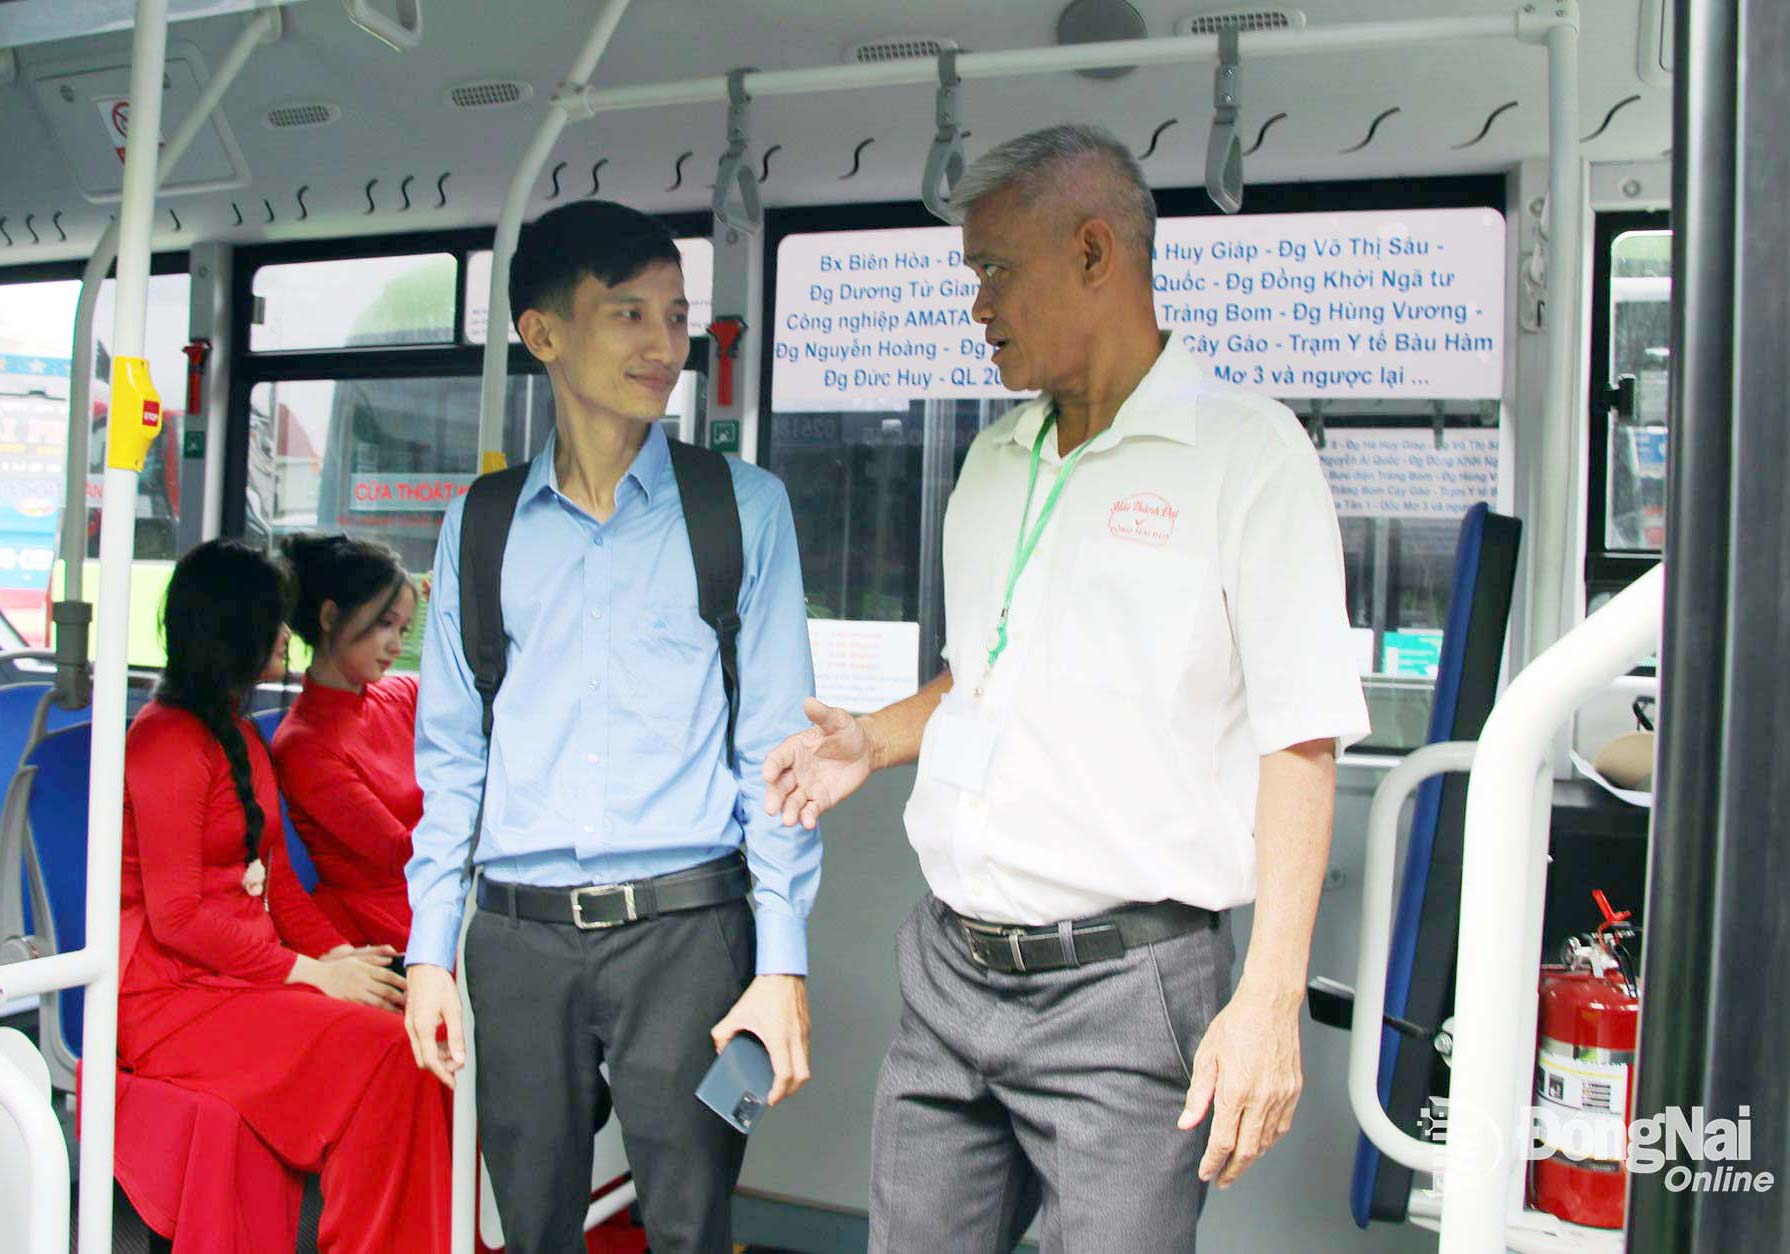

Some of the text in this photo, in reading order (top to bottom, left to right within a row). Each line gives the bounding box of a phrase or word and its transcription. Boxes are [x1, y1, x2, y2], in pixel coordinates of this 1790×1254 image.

[820, 255, 843, 272] Bx
[849, 252, 888, 271] Biên
[895, 250, 930, 269] Hòa
[1165, 243, 1203, 265] Huy
[1211, 240, 1259, 264] Giáp
[1278, 240, 1306, 262] Đg
[1313, 238, 1342, 257] Võ
[1350, 237, 1381, 261] Thị
[1389, 236, 1429, 256] Sáu
[809, 283, 834, 304] Đg
[840, 282, 902, 303] Dương
[909, 280, 934, 298] Từ
[1153, 270, 1206, 293] Quốc
[1226, 272, 1254, 295] Đg
[1261, 267, 1316, 294] Đồng
[1323, 268, 1374, 289] Khởi
[1382, 268, 1423, 292] Ngã
[1431, 270, 1456, 287] tư
[786, 309, 972, 333] Công nghiệp AMATA
[1226, 303, 1272, 322] Bom
[1293, 302, 1321, 325] Đg
[1329, 302, 1385, 325] Hùng
[1392, 300, 1467, 325] Vương
[775, 341, 799, 361] Đg
[805, 337, 872, 362] Nguyễn
[878, 338, 937, 359] Hoàng
[960, 338, 985, 360] Đg
[1289, 333, 1341, 357] Trạm
[1348, 333, 1361, 351] Y
[1368, 329, 1388, 351] tế
[1395, 332, 1436, 351] Bàu
[1445, 332, 1493, 351] Hàm
[824, 369, 847, 391] Đg
[854, 368, 890, 388] Đức
[897, 369, 932, 390] Huy
[951, 367, 978, 387] QL
[1214, 364, 1248, 384] Mơ
[1253, 364, 1264, 384] 3
[1272, 364, 1295, 384] và
[1303, 367, 1373, 389] ngược
[1381, 366, 1404, 389] lại
